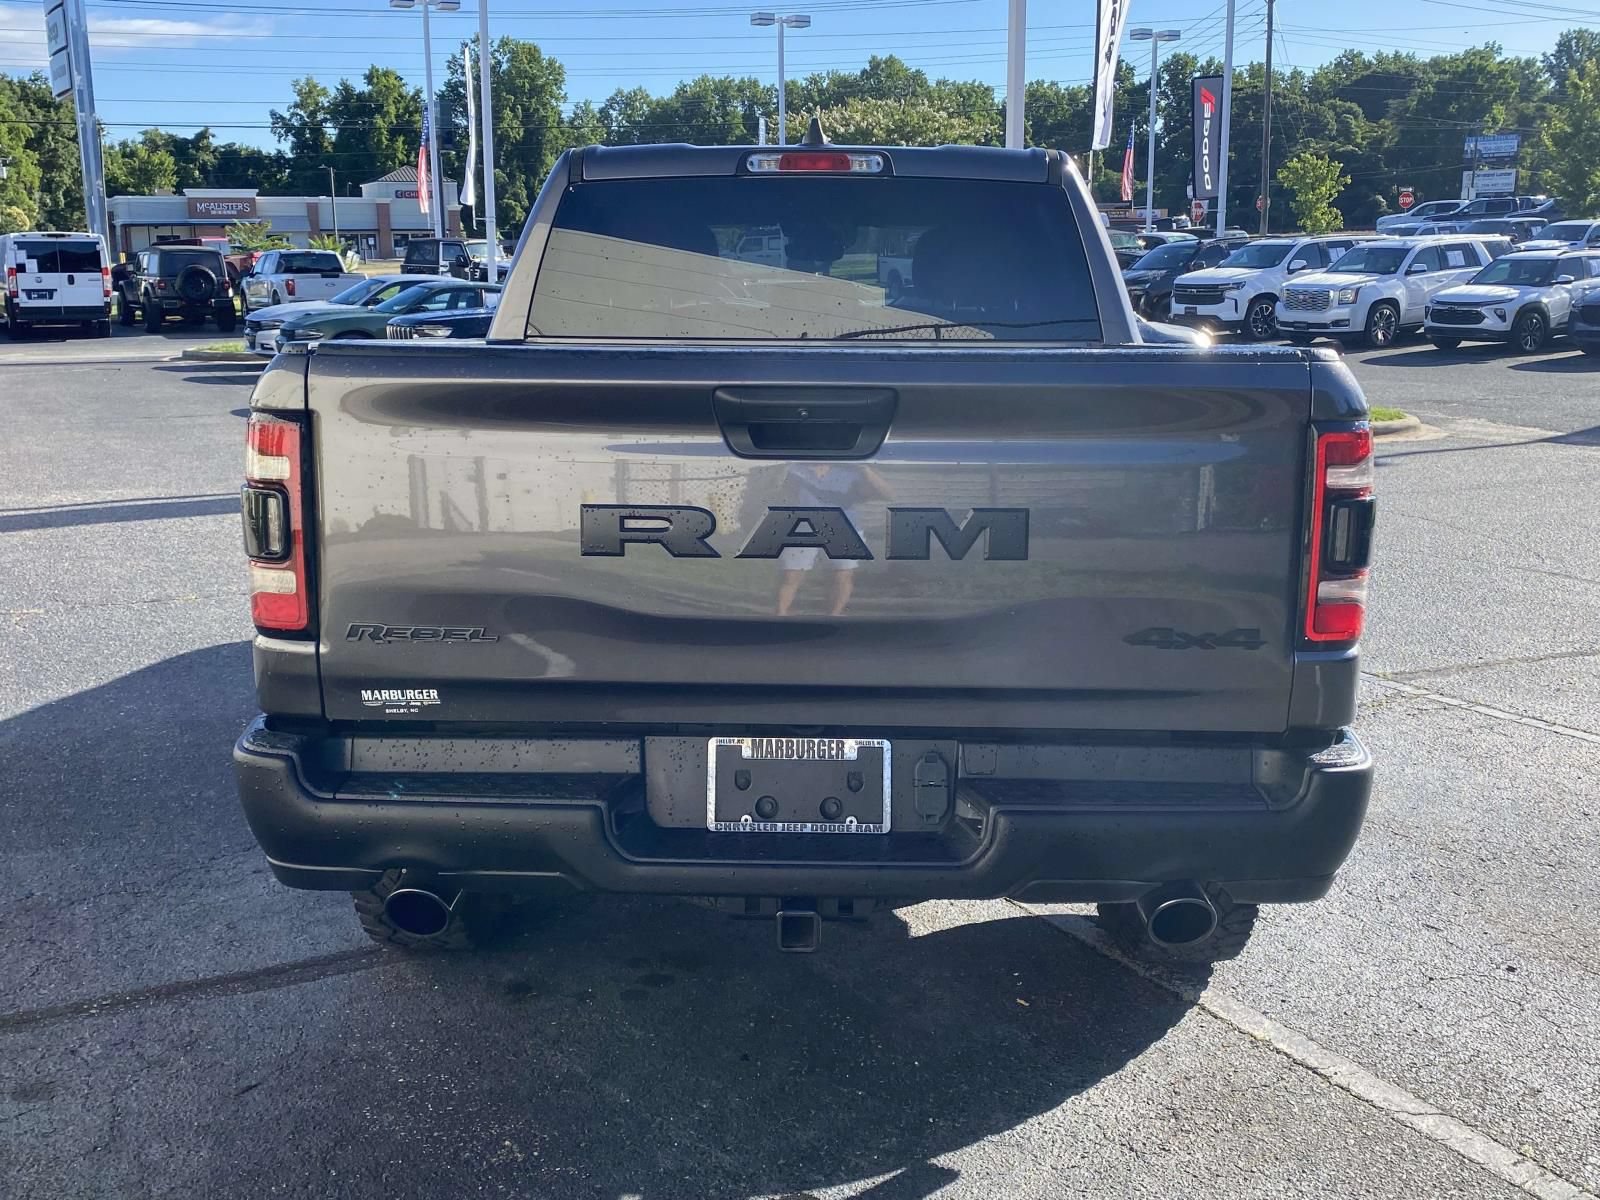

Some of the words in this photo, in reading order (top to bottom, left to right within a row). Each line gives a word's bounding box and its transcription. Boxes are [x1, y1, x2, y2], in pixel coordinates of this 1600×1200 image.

[1202, 103, 1212, 191] DODGE
[580, 503, 1030, 561] RAM
[345, 622, 500, 644] REBEL
[1121, 627, 1268, 650] 4x4
[361, 689, 439, 701] MARBURGER
[751, 738, 845, 760] MARBURGER
[715, 822, 780, 832] CHRYSLER
[781, 823, 808, 832] JEEP
[811, 823, 853, 833] DODGE
[856, 824, 883, 833] RAM
